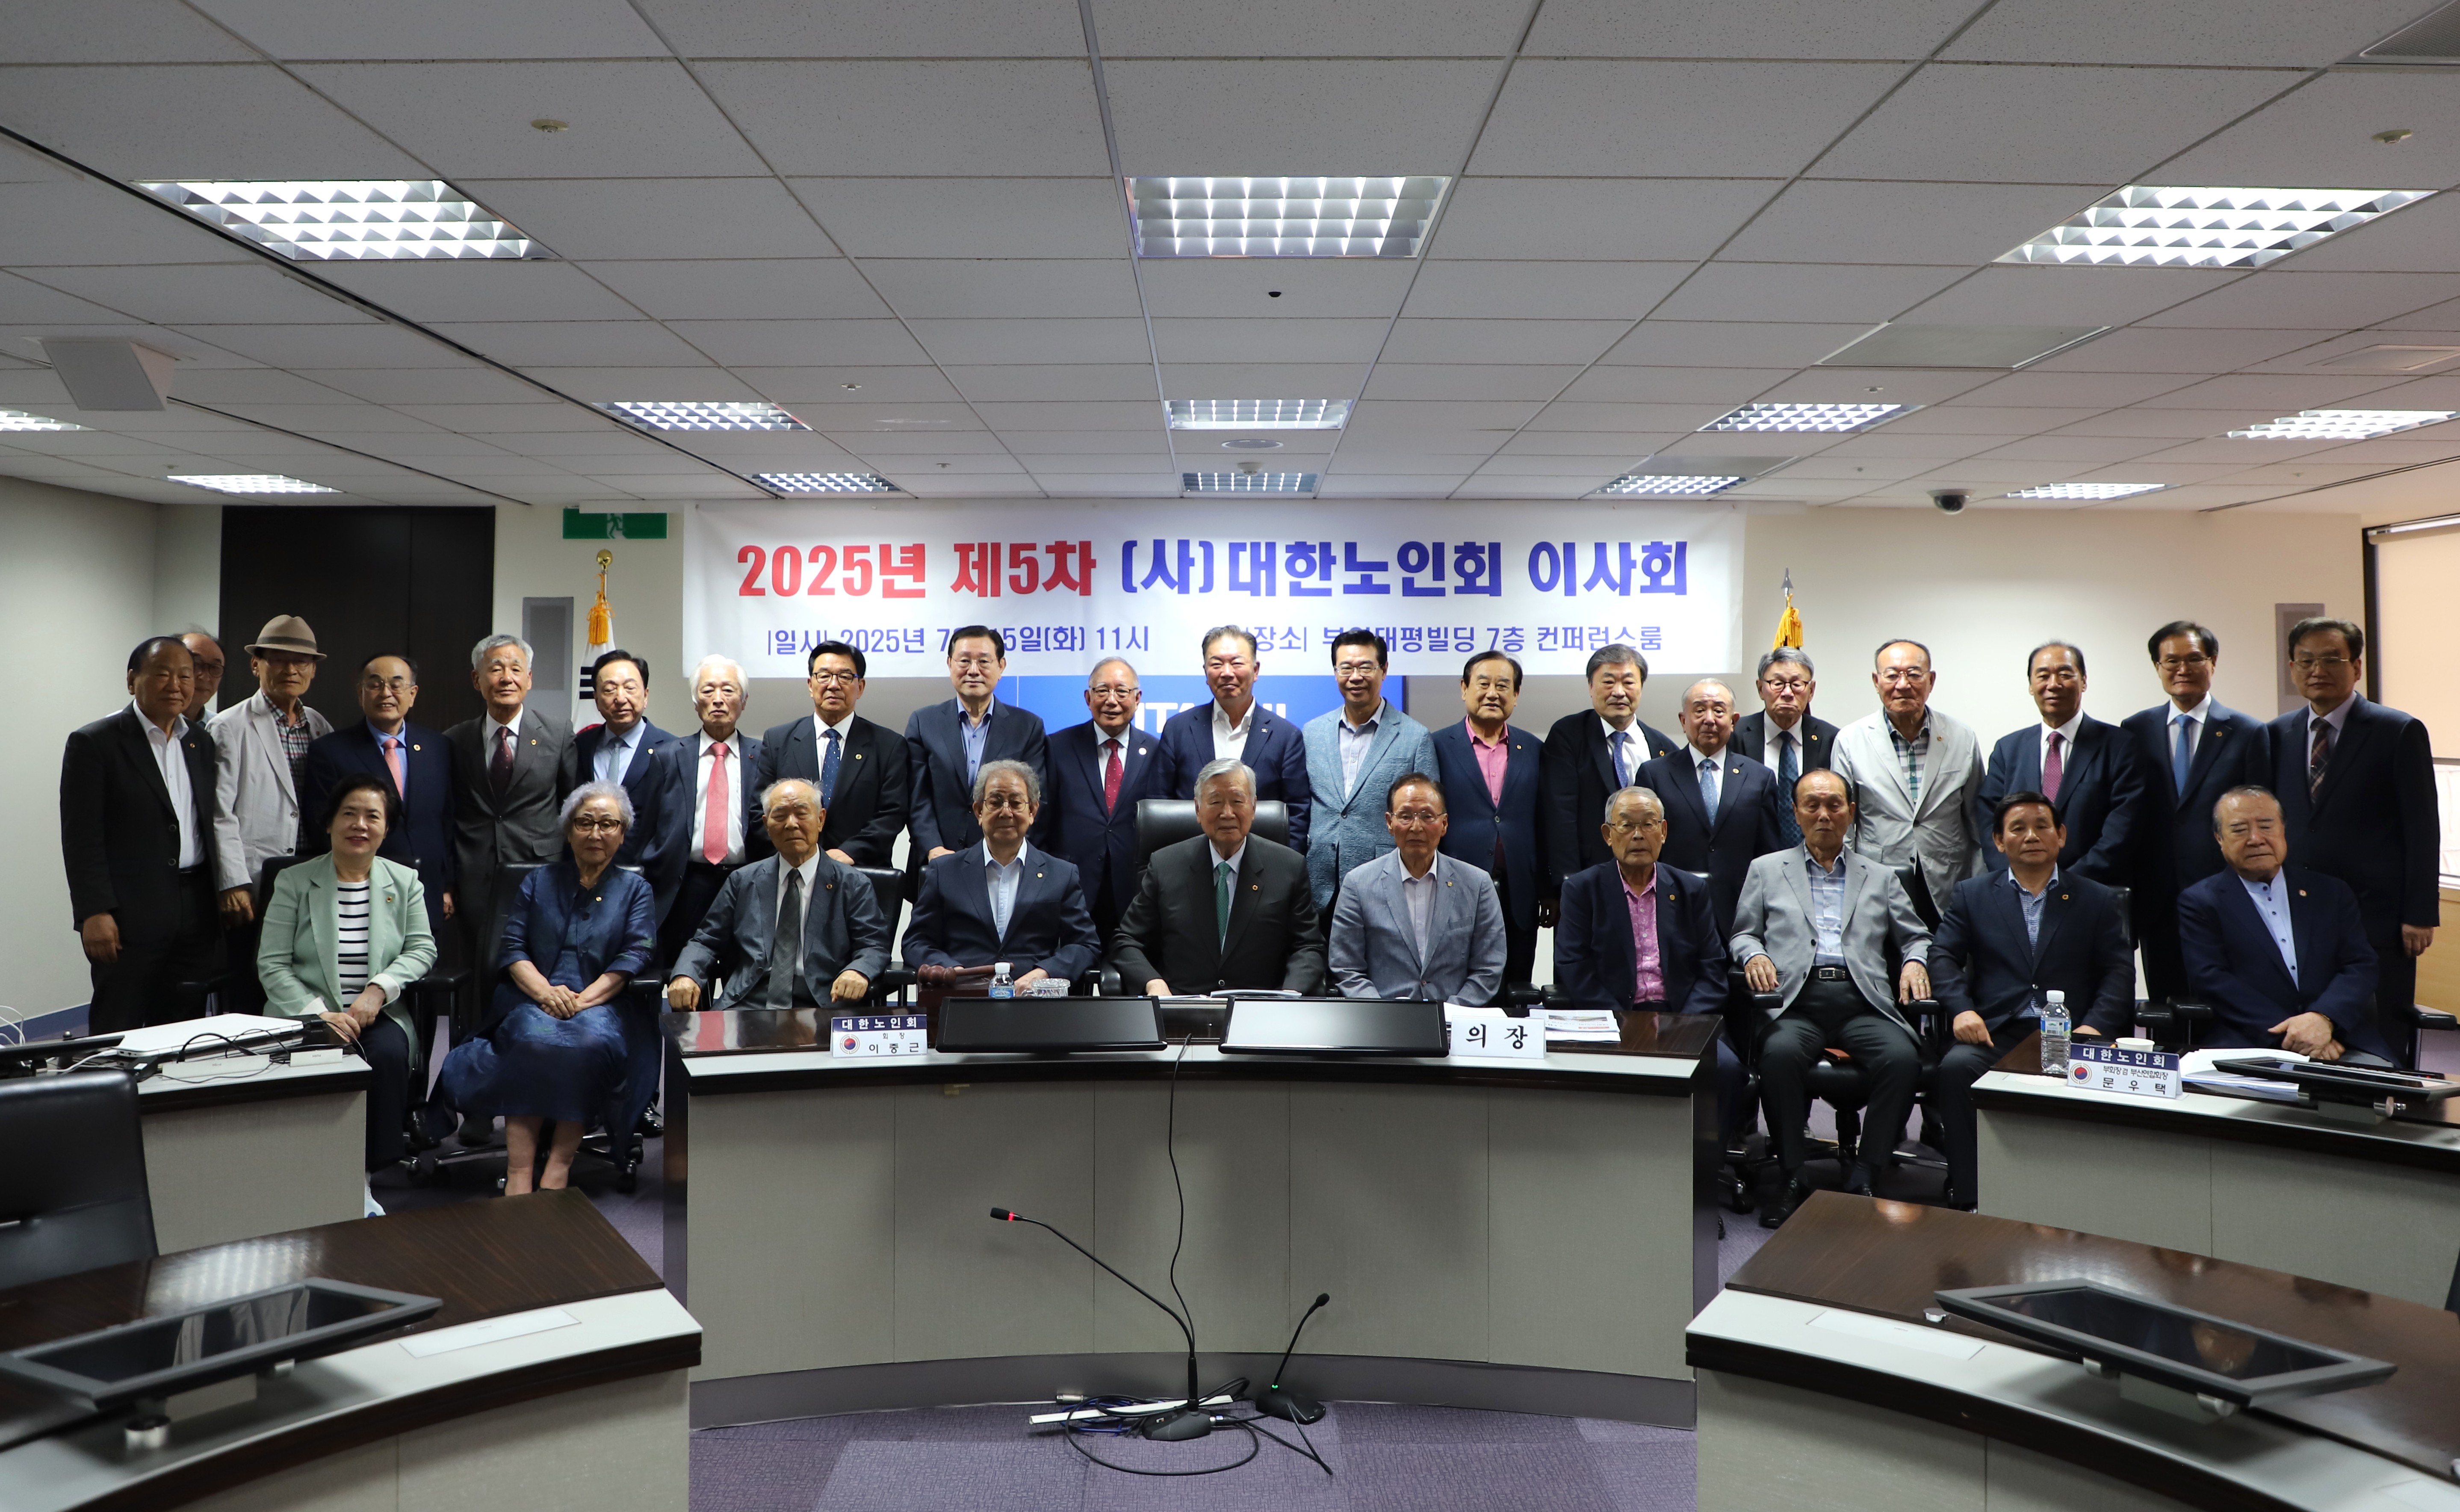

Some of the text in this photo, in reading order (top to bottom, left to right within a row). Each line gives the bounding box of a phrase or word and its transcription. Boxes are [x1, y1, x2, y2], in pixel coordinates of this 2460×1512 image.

[738, 543, 926, 599] 2025년
[950, 540, 1096, 598] 제5차
[1528, 540, 1688, 597] 이사회
[840, 628, 924, 653] 2025년
[993, 626, 1085, 652] 5일(화)
[1096, 626, 1149, 652] 11시
[1486, 626, 1525, 653] 7층
[1537, 626, 1662, 651] 컨퍼런스룸
